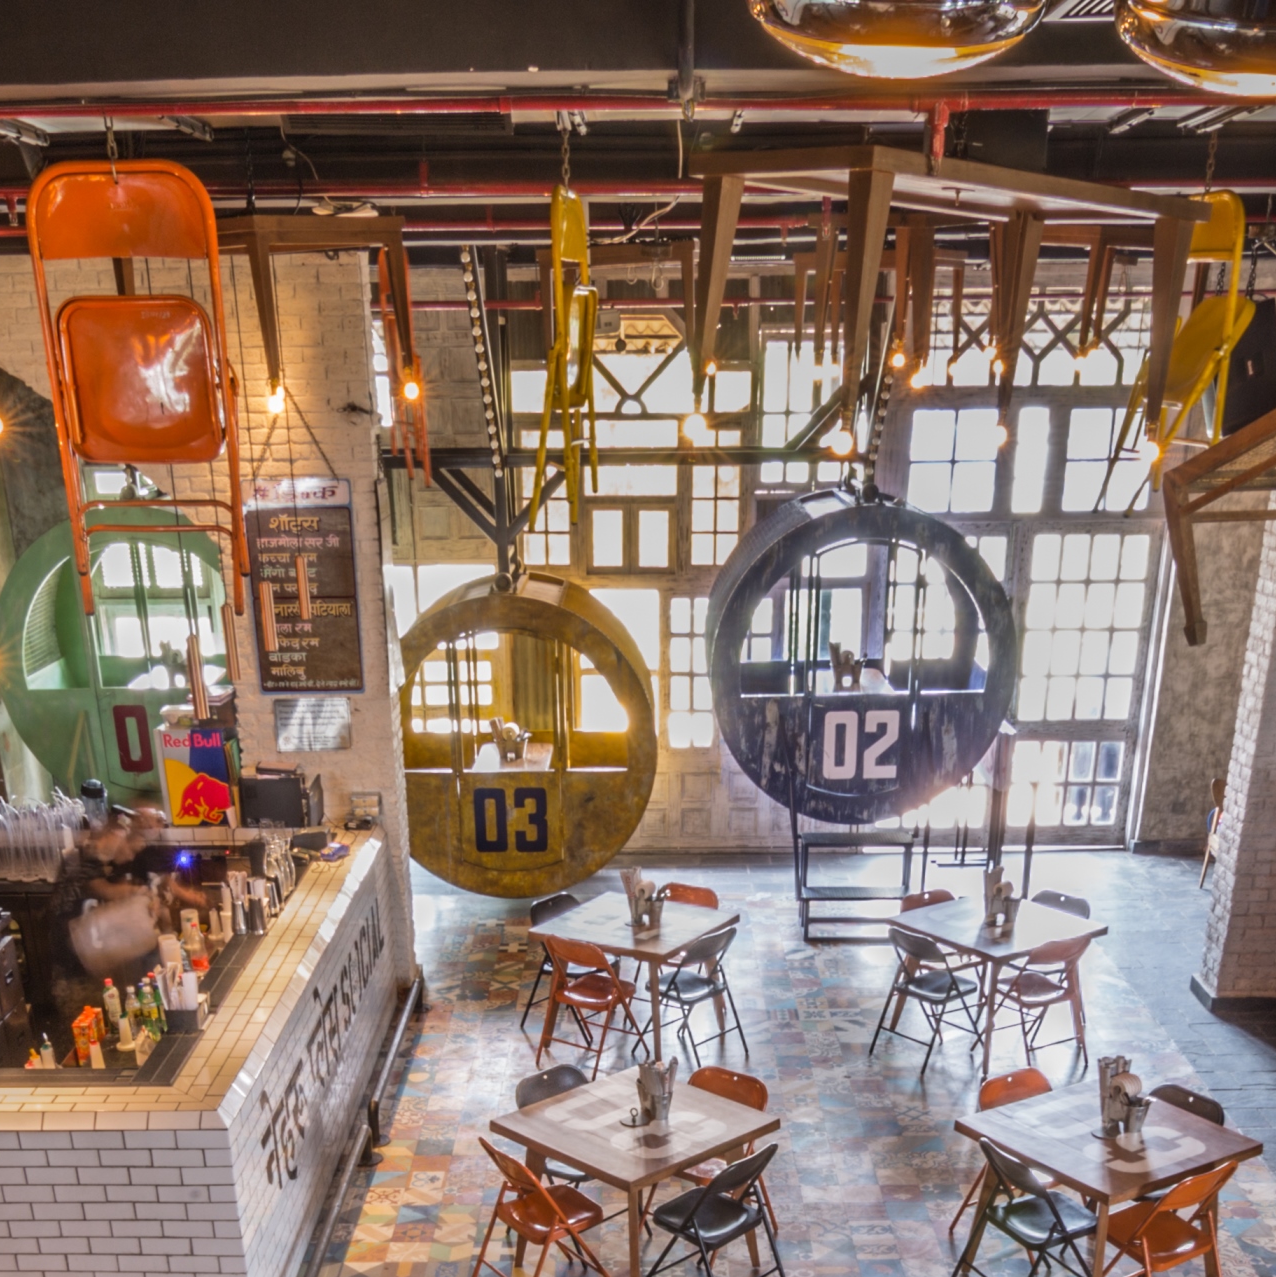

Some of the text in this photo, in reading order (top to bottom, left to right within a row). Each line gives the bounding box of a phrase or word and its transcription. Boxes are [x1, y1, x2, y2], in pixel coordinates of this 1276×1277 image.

[162, 732, 222, 748] Red Bull
[822, 711, 900, 780] 02
[474, 788, 548, 853] 03
